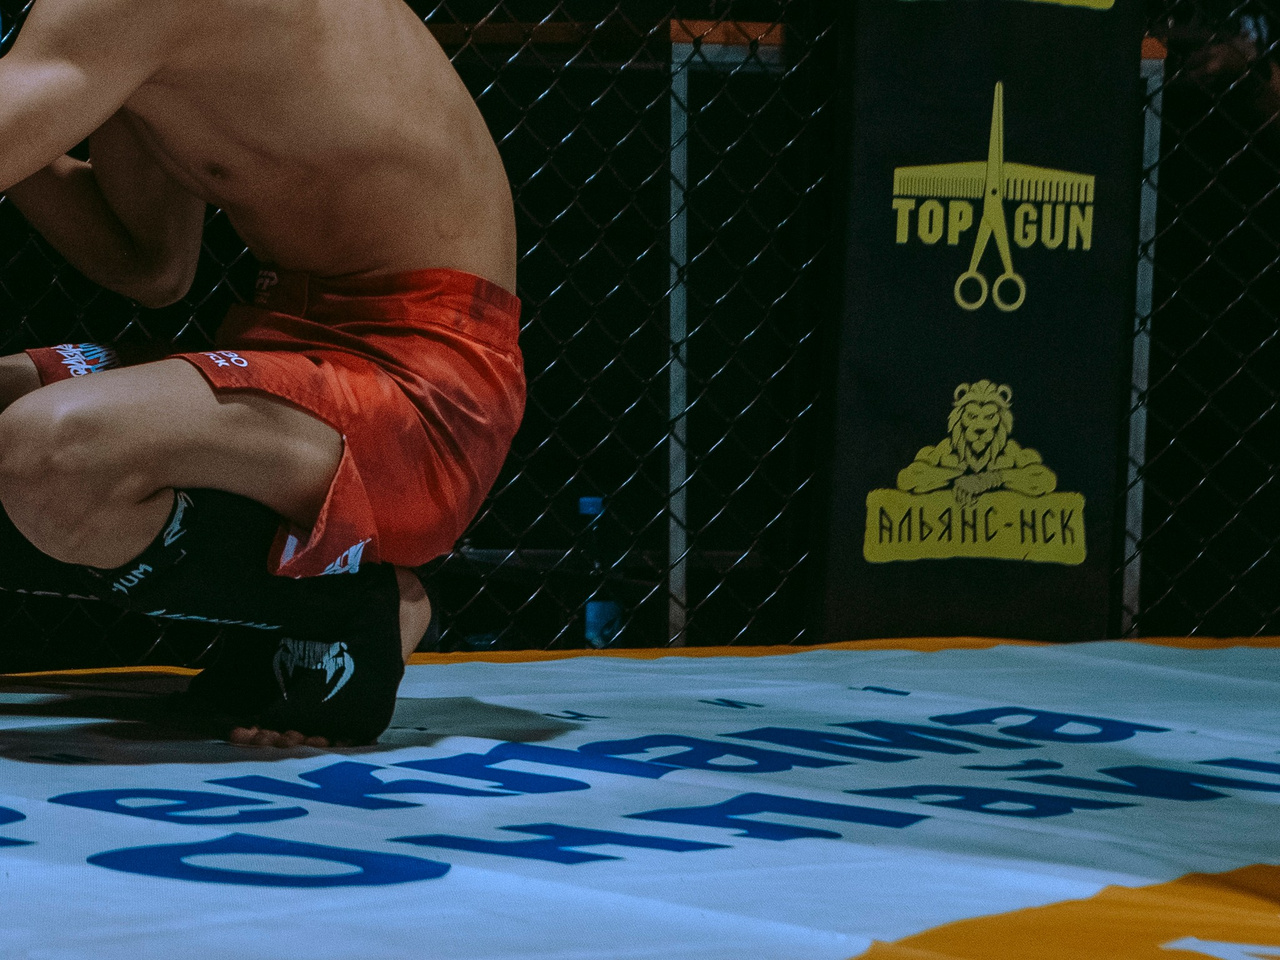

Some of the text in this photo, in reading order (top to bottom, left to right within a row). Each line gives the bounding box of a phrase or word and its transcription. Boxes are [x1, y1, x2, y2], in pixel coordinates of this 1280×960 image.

[892, 198, 1095, 251] TOP GUN
[877, 505, 1076, 545] АЛЬЯНС-НСК
